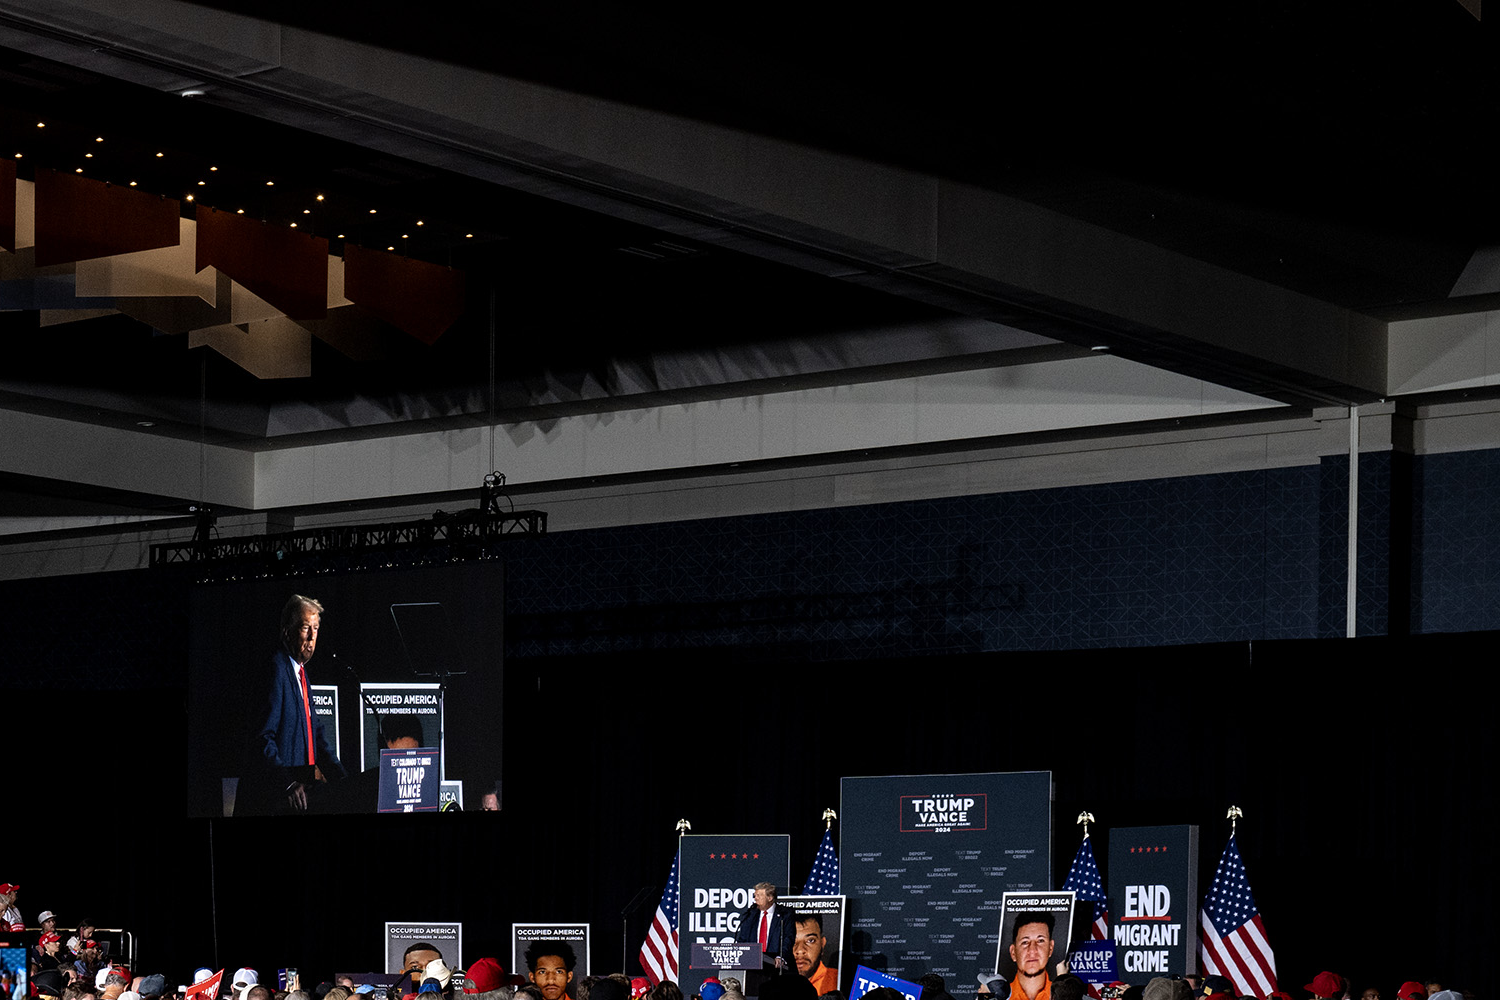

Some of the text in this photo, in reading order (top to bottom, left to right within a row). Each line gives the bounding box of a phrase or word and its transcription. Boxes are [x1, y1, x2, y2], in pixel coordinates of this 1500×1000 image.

[404, 695, 438, 704] AMERICA
[396, 767, 425, 784] TRUMP
[398, 784, 421, 798] VANCE
[912, 798, 975, 812] TRUMP
[919, 812, 968, 823] VANCE
[1125, 885, 1171, 917] END
[689, 912, 740, 932] ILLEG
[1114, 924, 1181, 946] MIGRANT
[1069, 951, 1113, 962] TRUMP
[1124, 950, 1169, 972] CRIME
[1071, 961, 1108, 970] VANCE
